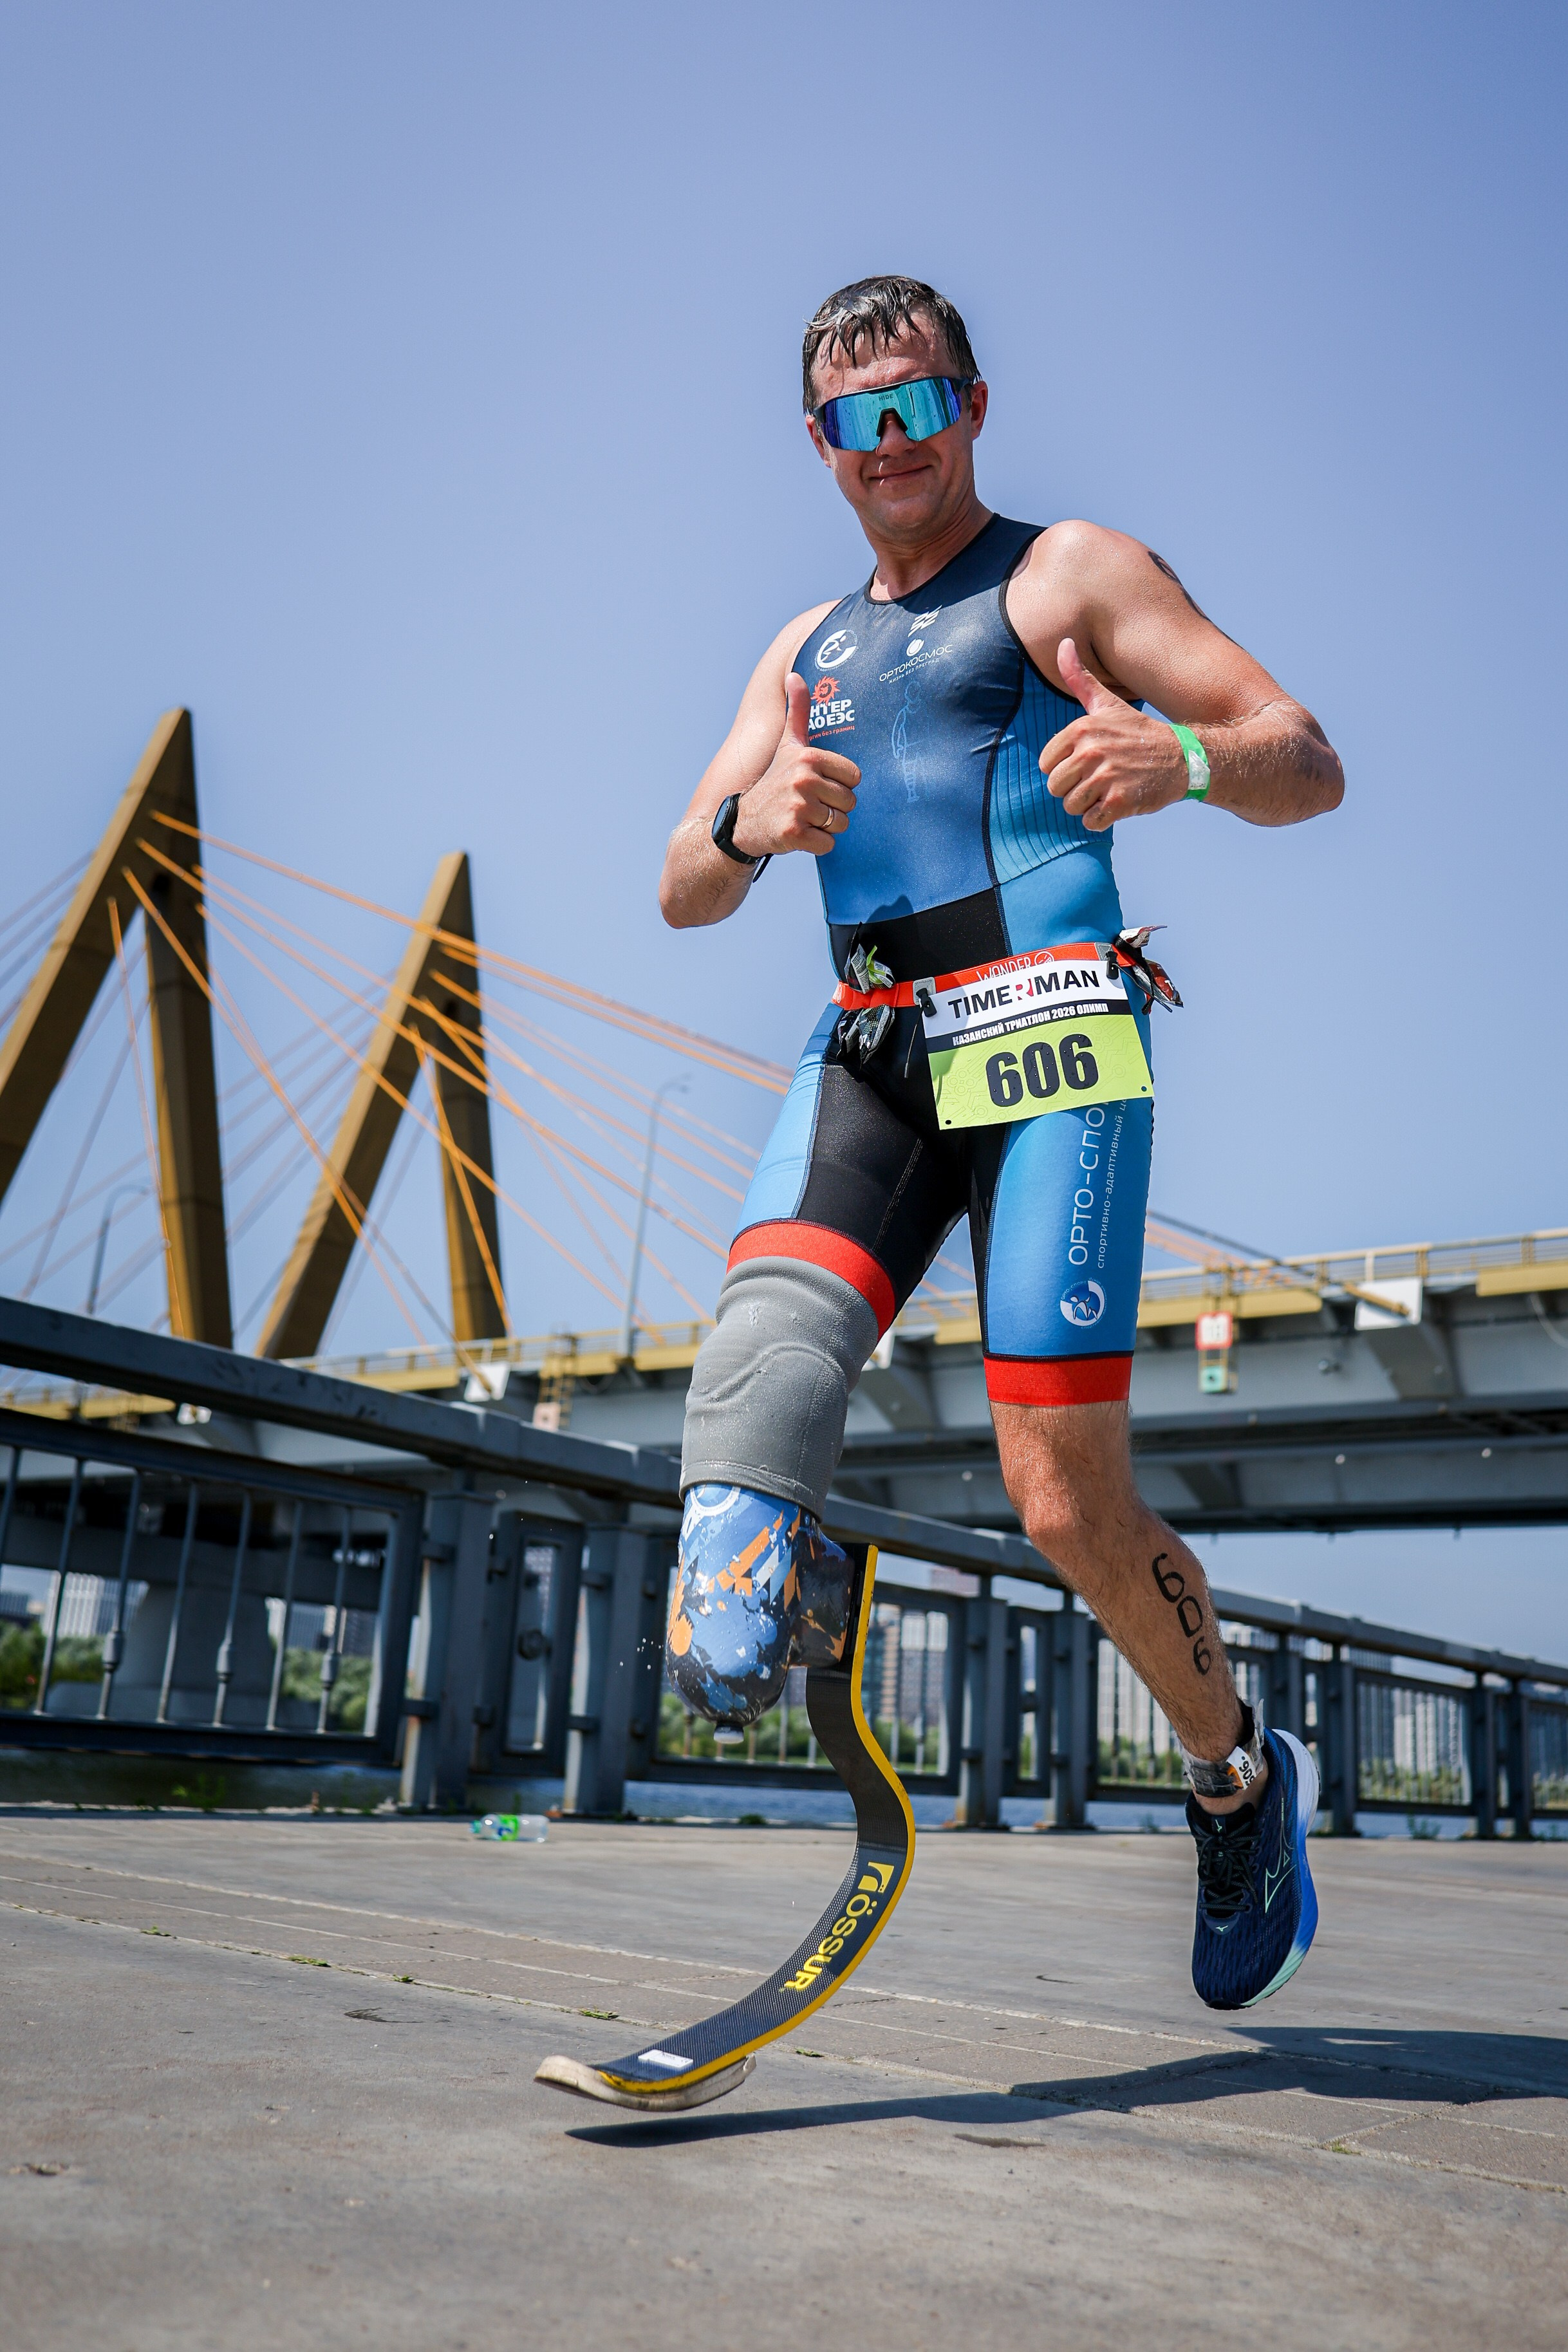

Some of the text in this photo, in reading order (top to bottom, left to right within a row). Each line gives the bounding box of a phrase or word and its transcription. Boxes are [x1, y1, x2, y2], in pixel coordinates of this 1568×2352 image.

[879, 644, 953, 682] ОРТОКОСМОС
[915, 657, 940, 671] ПРЕГРАД
[808, 716, 825, 731] АО
[810, 699, 852, 718] НТЕР
[833, 725, 855, 735] границ
[976, 957, 1031, 981] WONDER
[948, 970, 1100, 1019] TIMERMAN
[952, 1003, 1109, 1047] КАЗАНСКИЙ ТРИАТЛОН 2026 ОЛИМП
[985, 1034, 1099, 1107] 606
[1068, 1103, 1109, 1265] ОРТО-СПО
[1097, 1115, 1124, 1269] спортивно-адаптивный
[1152, 1553, 1212, 1675] 606
